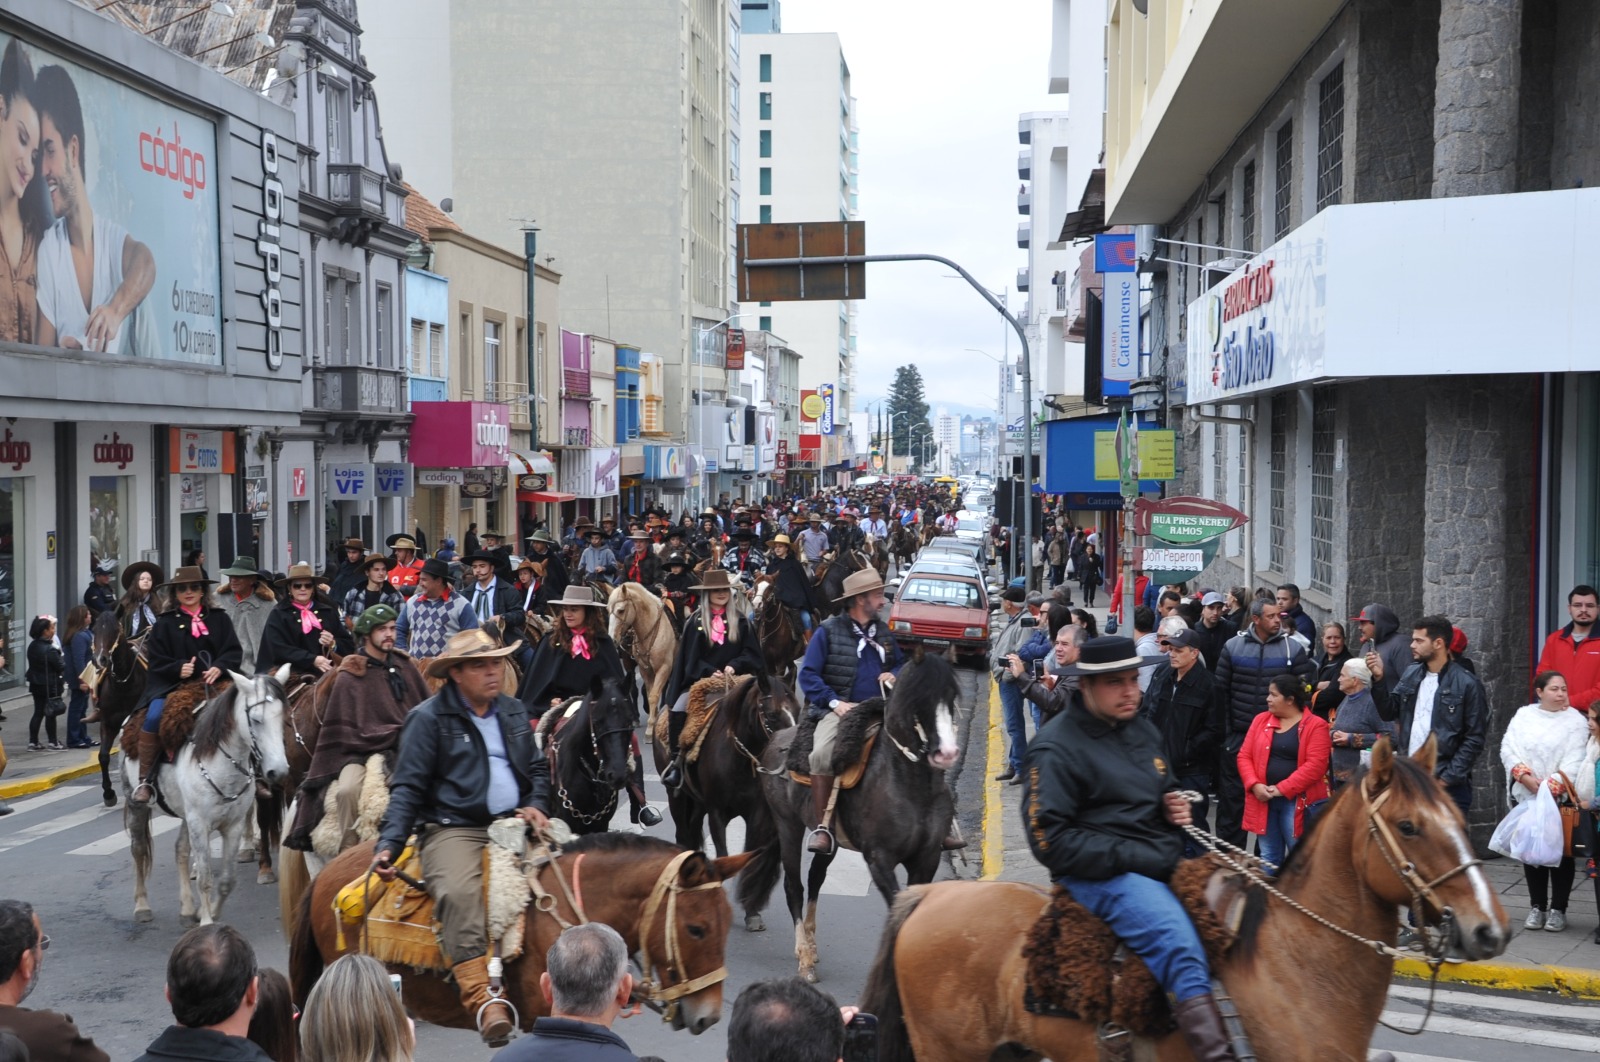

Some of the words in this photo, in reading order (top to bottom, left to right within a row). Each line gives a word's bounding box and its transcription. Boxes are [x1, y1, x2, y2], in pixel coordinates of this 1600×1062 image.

[138, 121, 206, 200] código
[256, 127, 284, 371] código
[1223, 259, 1275, 323] FARMÁCIAS
[1117, 281, 1131, 368] Catarinense
[1221, 330, 1243, 391] São
[1242, 316, 1275, 386] João
[822, 396, 832, 434] Colombo
[93, 432, 134, 470] código
[197, 448, 218, 468] FOTOS
[778, 441, 787, 467] FOTO
[334, 468, 365, 479] Lojas
[376, 467, 405, 477] Lojas
[425, 472, 457, 484] código
[335, 479, 365, 495] VF
[377, 477, 405, 492] VF
[1152, 515, 1171, 525] RUA
[1172, 516, 1198, 526] PRES
[1198, 517, 1230, 527] NEREU
[1169, 526, 1203, 536] RAMOS
[1143, 548, 1162, 562] Don
